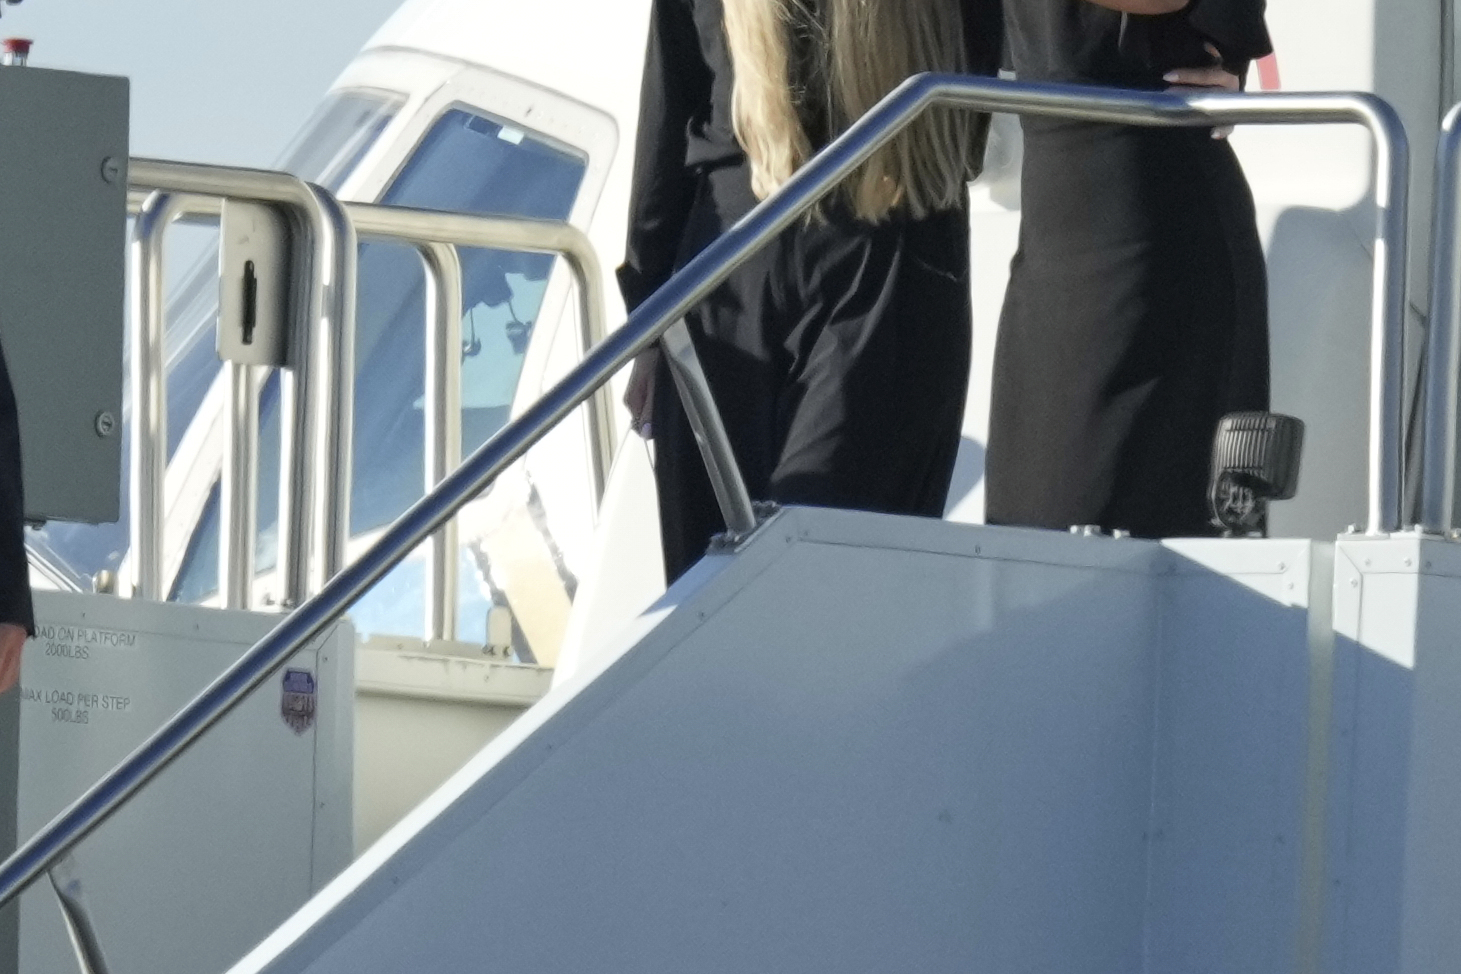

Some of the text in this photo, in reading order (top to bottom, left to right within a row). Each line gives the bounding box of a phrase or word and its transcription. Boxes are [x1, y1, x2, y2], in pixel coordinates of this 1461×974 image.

[57, 627, 74, 642] ON
[77, 629, 136, 647] PLATFORM
[45, 642, 89, 660] 2000LBS
[45, 689, 74, 706] LOAD
[77, 693, 98, 708] PER
[102, 695, 131, 710] STEP
